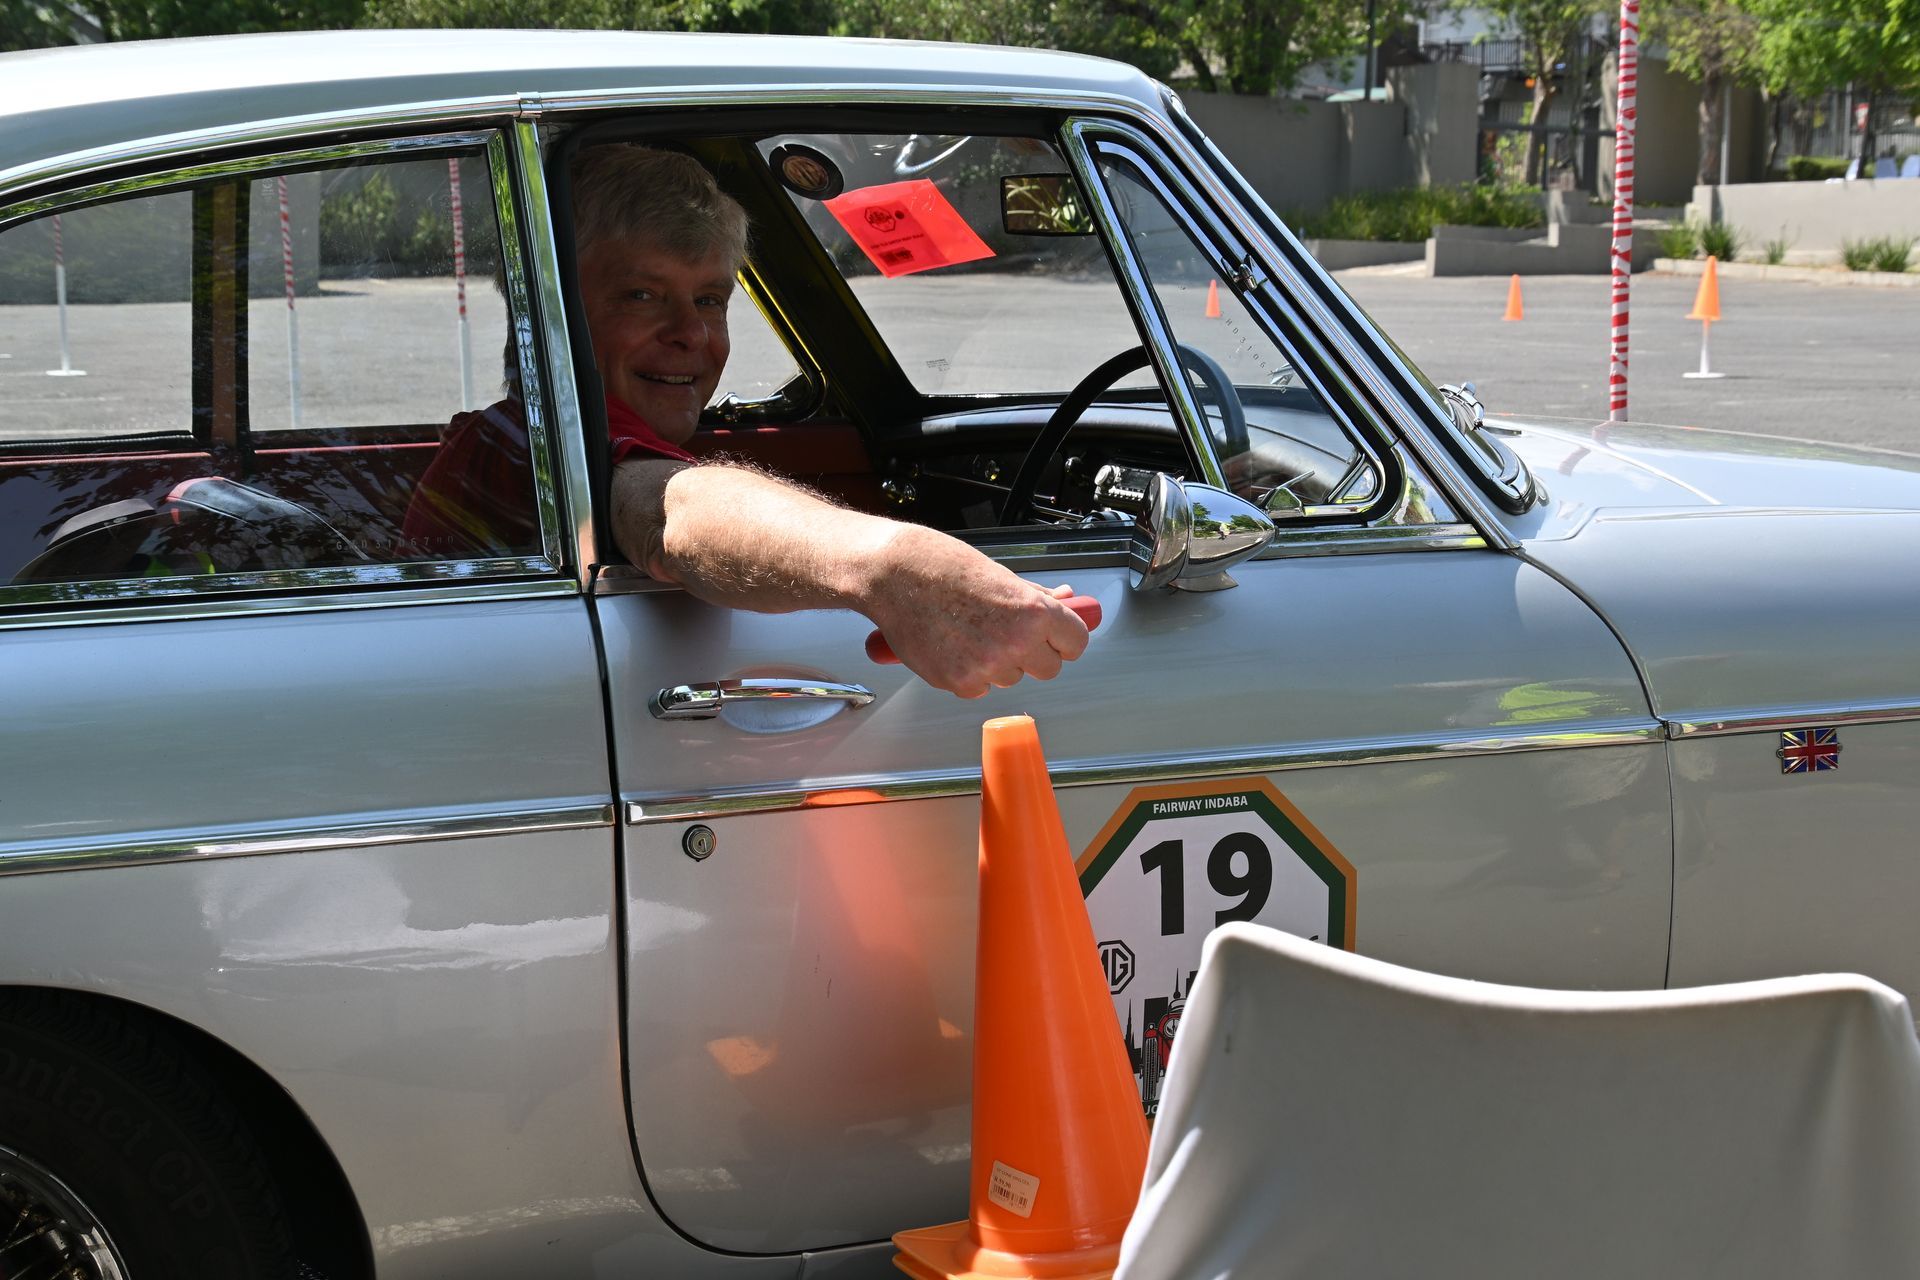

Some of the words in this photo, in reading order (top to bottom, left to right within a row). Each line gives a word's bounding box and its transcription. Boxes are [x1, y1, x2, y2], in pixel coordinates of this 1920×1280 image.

[1153, 800, 1203, 814] FAIRWAY
[1205, 796, 1248, 809] INDABA
[1140, 831, 1273, 936] 19
